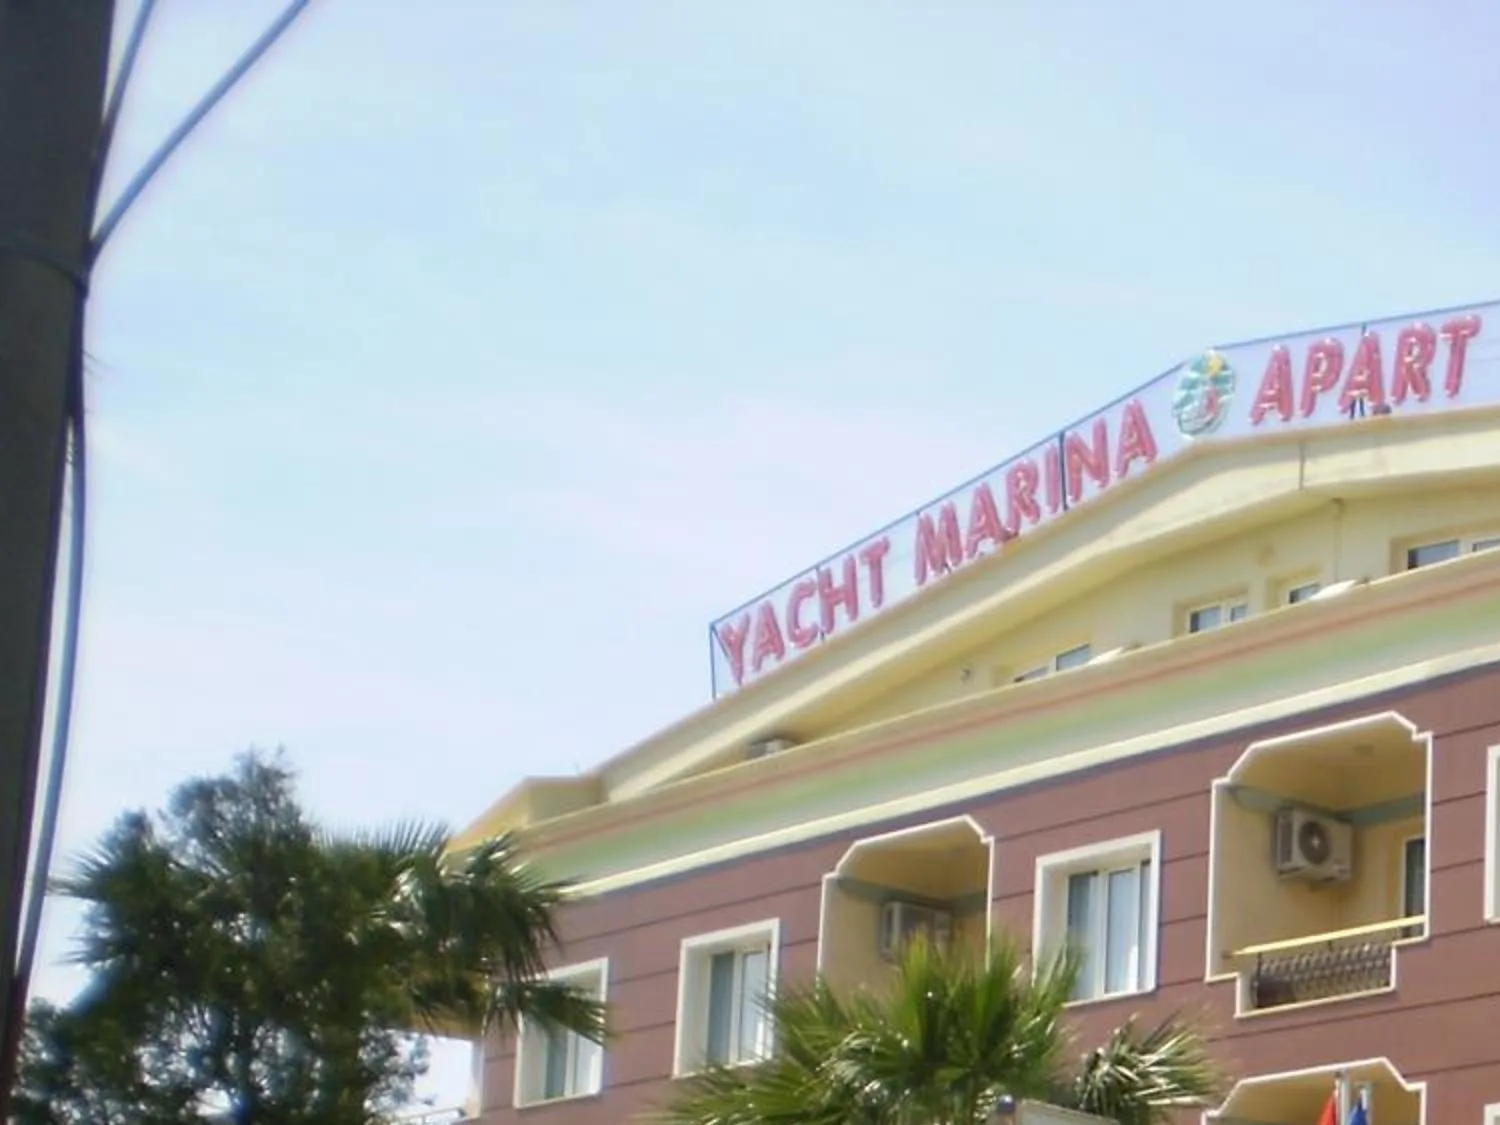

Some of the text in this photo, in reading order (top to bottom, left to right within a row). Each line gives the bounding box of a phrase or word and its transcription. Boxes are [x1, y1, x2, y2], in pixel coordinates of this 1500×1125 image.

[718, 537, 891, 687] YACHT
[914, 399, 1159, 586] MARINA
[1250, 315, 1482, 425] APART
